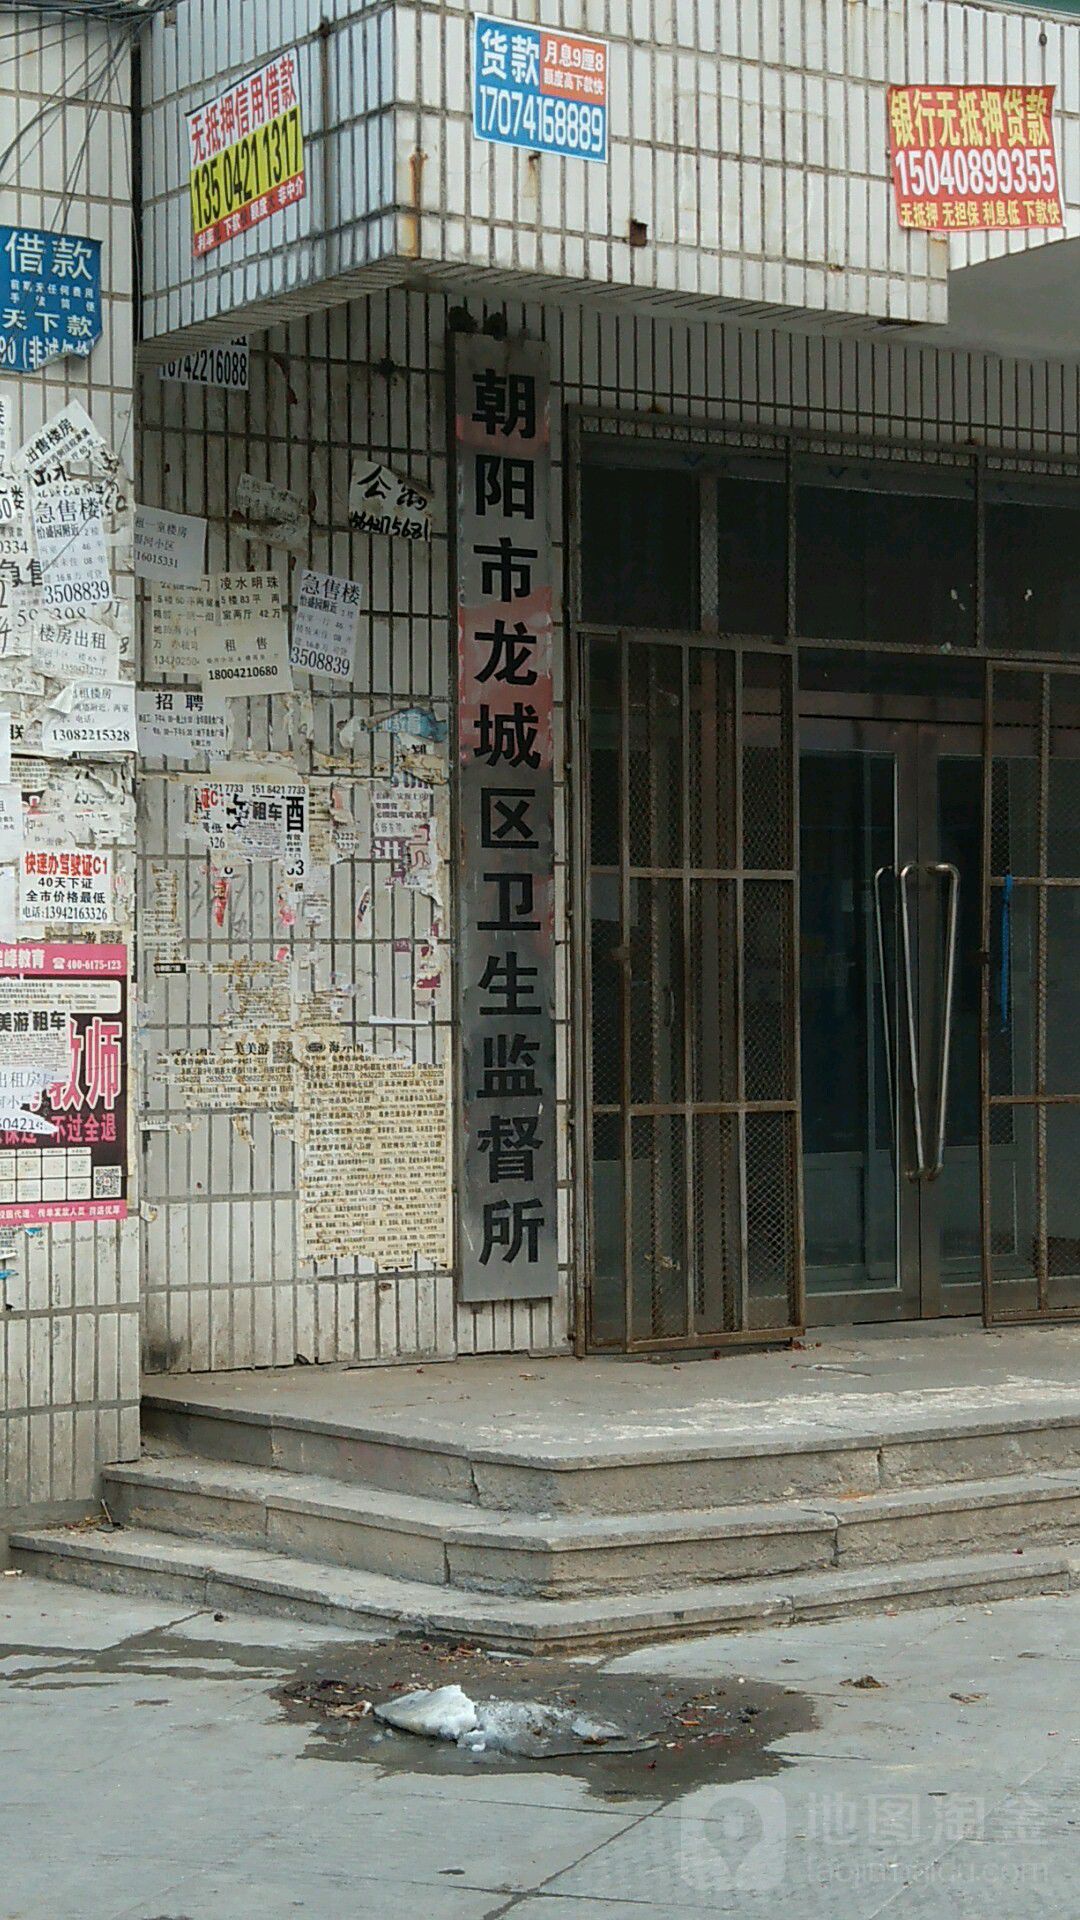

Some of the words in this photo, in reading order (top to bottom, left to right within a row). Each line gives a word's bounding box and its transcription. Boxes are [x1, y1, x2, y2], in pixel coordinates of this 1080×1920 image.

[191, 54, 297, 165] 无抵押信用借款
[480, 85, 604, 153] 17074168889
[891, 89, 1050, 148] 银行无抵押贷款
[194, 158, 222, 229] 135
[222, 131, 261, 213] 0421
[262, 109, 299, 188] 1317
[895, 148, 1056, 196] 15040899355
[901, 201, 939, 227] 无抵押
[942, 202, 980, 227] 无担保
[983, 201, 1021, 226] 利息低
[1022, 199, 1061, 226] 下款快
[5, 231, 94, 281] 借款
[35, 497, 99, 524] 急售楼
[44, 579, 110, 605] 3508839
[220, 575, 280, 591] 凌水明珠
[302, 573, 361, 606] 急售楼
[40, 623, 107, 650] 楼房出租
[208, 665, 279, 681] 18004210680
[290, 646, 351, 676] 3508839
[156, 693, 204, 712] 招聘
[51, 728, 130, 743] 13082215328
[472, 368, 546, 1266] 朝阳市龙城区卫生监督所
[25, 851, 108, 877] 快速办驾驶证C1
[38, 876, 94, 889] 40天下证
[26, 889, 106, 904] 全市价格最低
